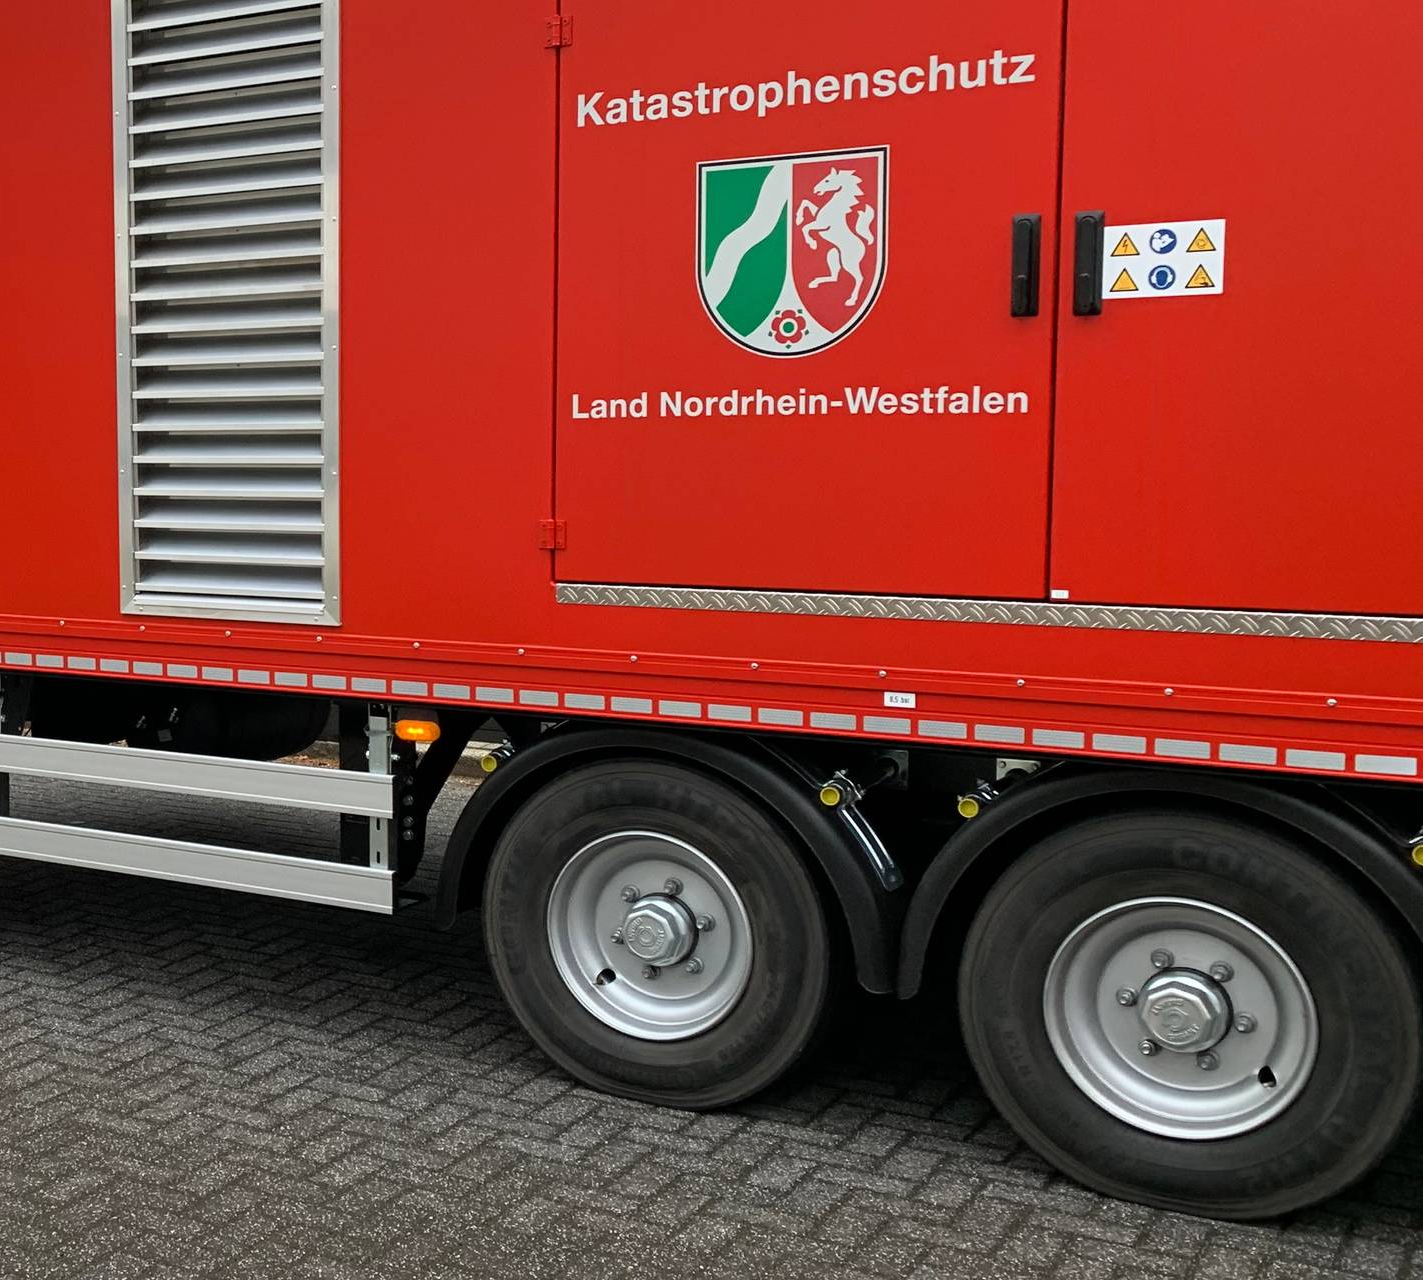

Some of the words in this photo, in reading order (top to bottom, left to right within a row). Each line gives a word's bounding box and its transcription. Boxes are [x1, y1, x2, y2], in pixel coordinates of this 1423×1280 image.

[577, 49, 1036, 128] Katastrophenschutz
[572, 391, 648, 419] Land
[660, 385, 1029, 417] Nordrhein-Westfalen
